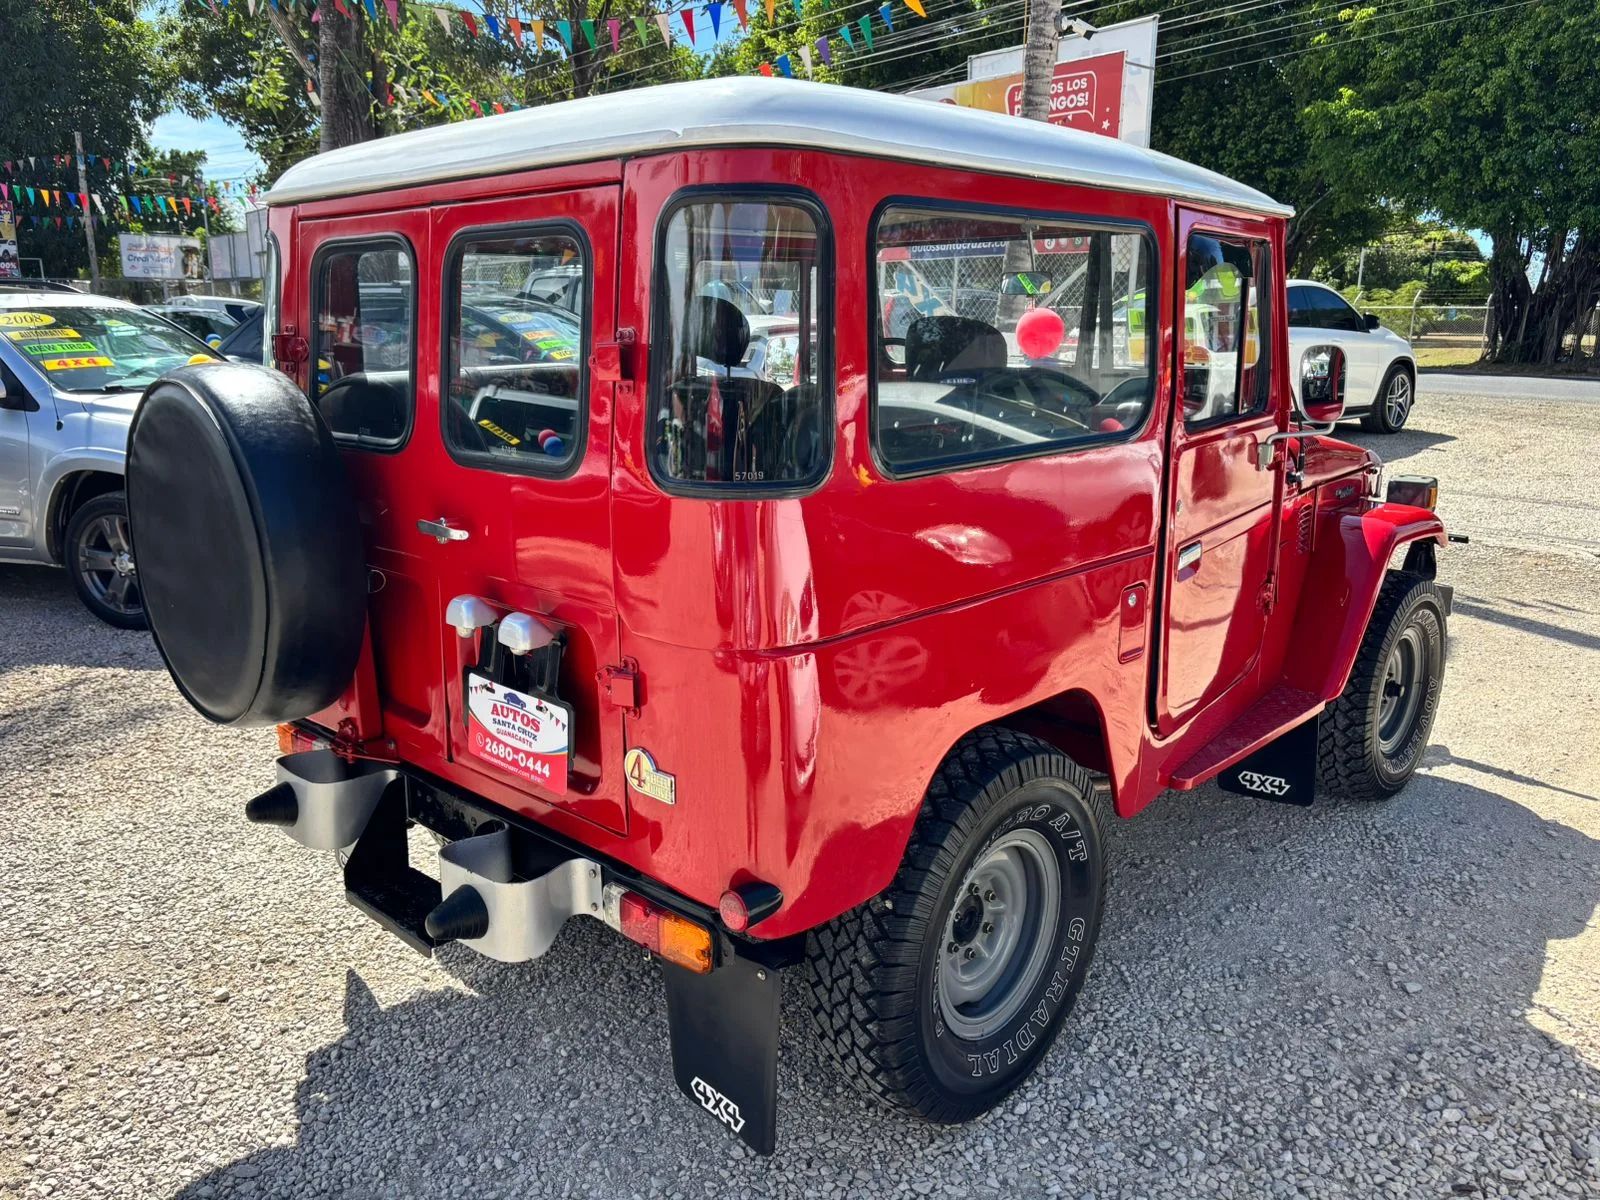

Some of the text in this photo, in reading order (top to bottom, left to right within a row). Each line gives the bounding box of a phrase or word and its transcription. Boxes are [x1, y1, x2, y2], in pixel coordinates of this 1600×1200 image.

[1066, 77, 1088, 92] LOS
[1014, 92, 1089, 117] DNGOS!
[912, 241, 1007, 253] autossantacruzcr.co
[3, 314, 44, 325] 2008
[18, 329, 71, 338] AUTOMATIC
[28, 342, 92, 352] NEW TIRES
[735, 471, 764, 480] 57019
[491, 703, 541, 733] AUTOS
[492, 718, 538, 742] SANTA CRUZ
[496, 727, 533, 749] GUANACASTE
[485, 737, 551, 778] 2680-0444
[630, 753, 646, 789] 4
[1238, 770, 1291, 796] 4X4
[1050, 812, 1088, 862] A/T
[1061, 917, 1086, 972] GT
[968, 971, 1069, 1077] RADIAL
[690, 1076, 746, 1133] 4X4
